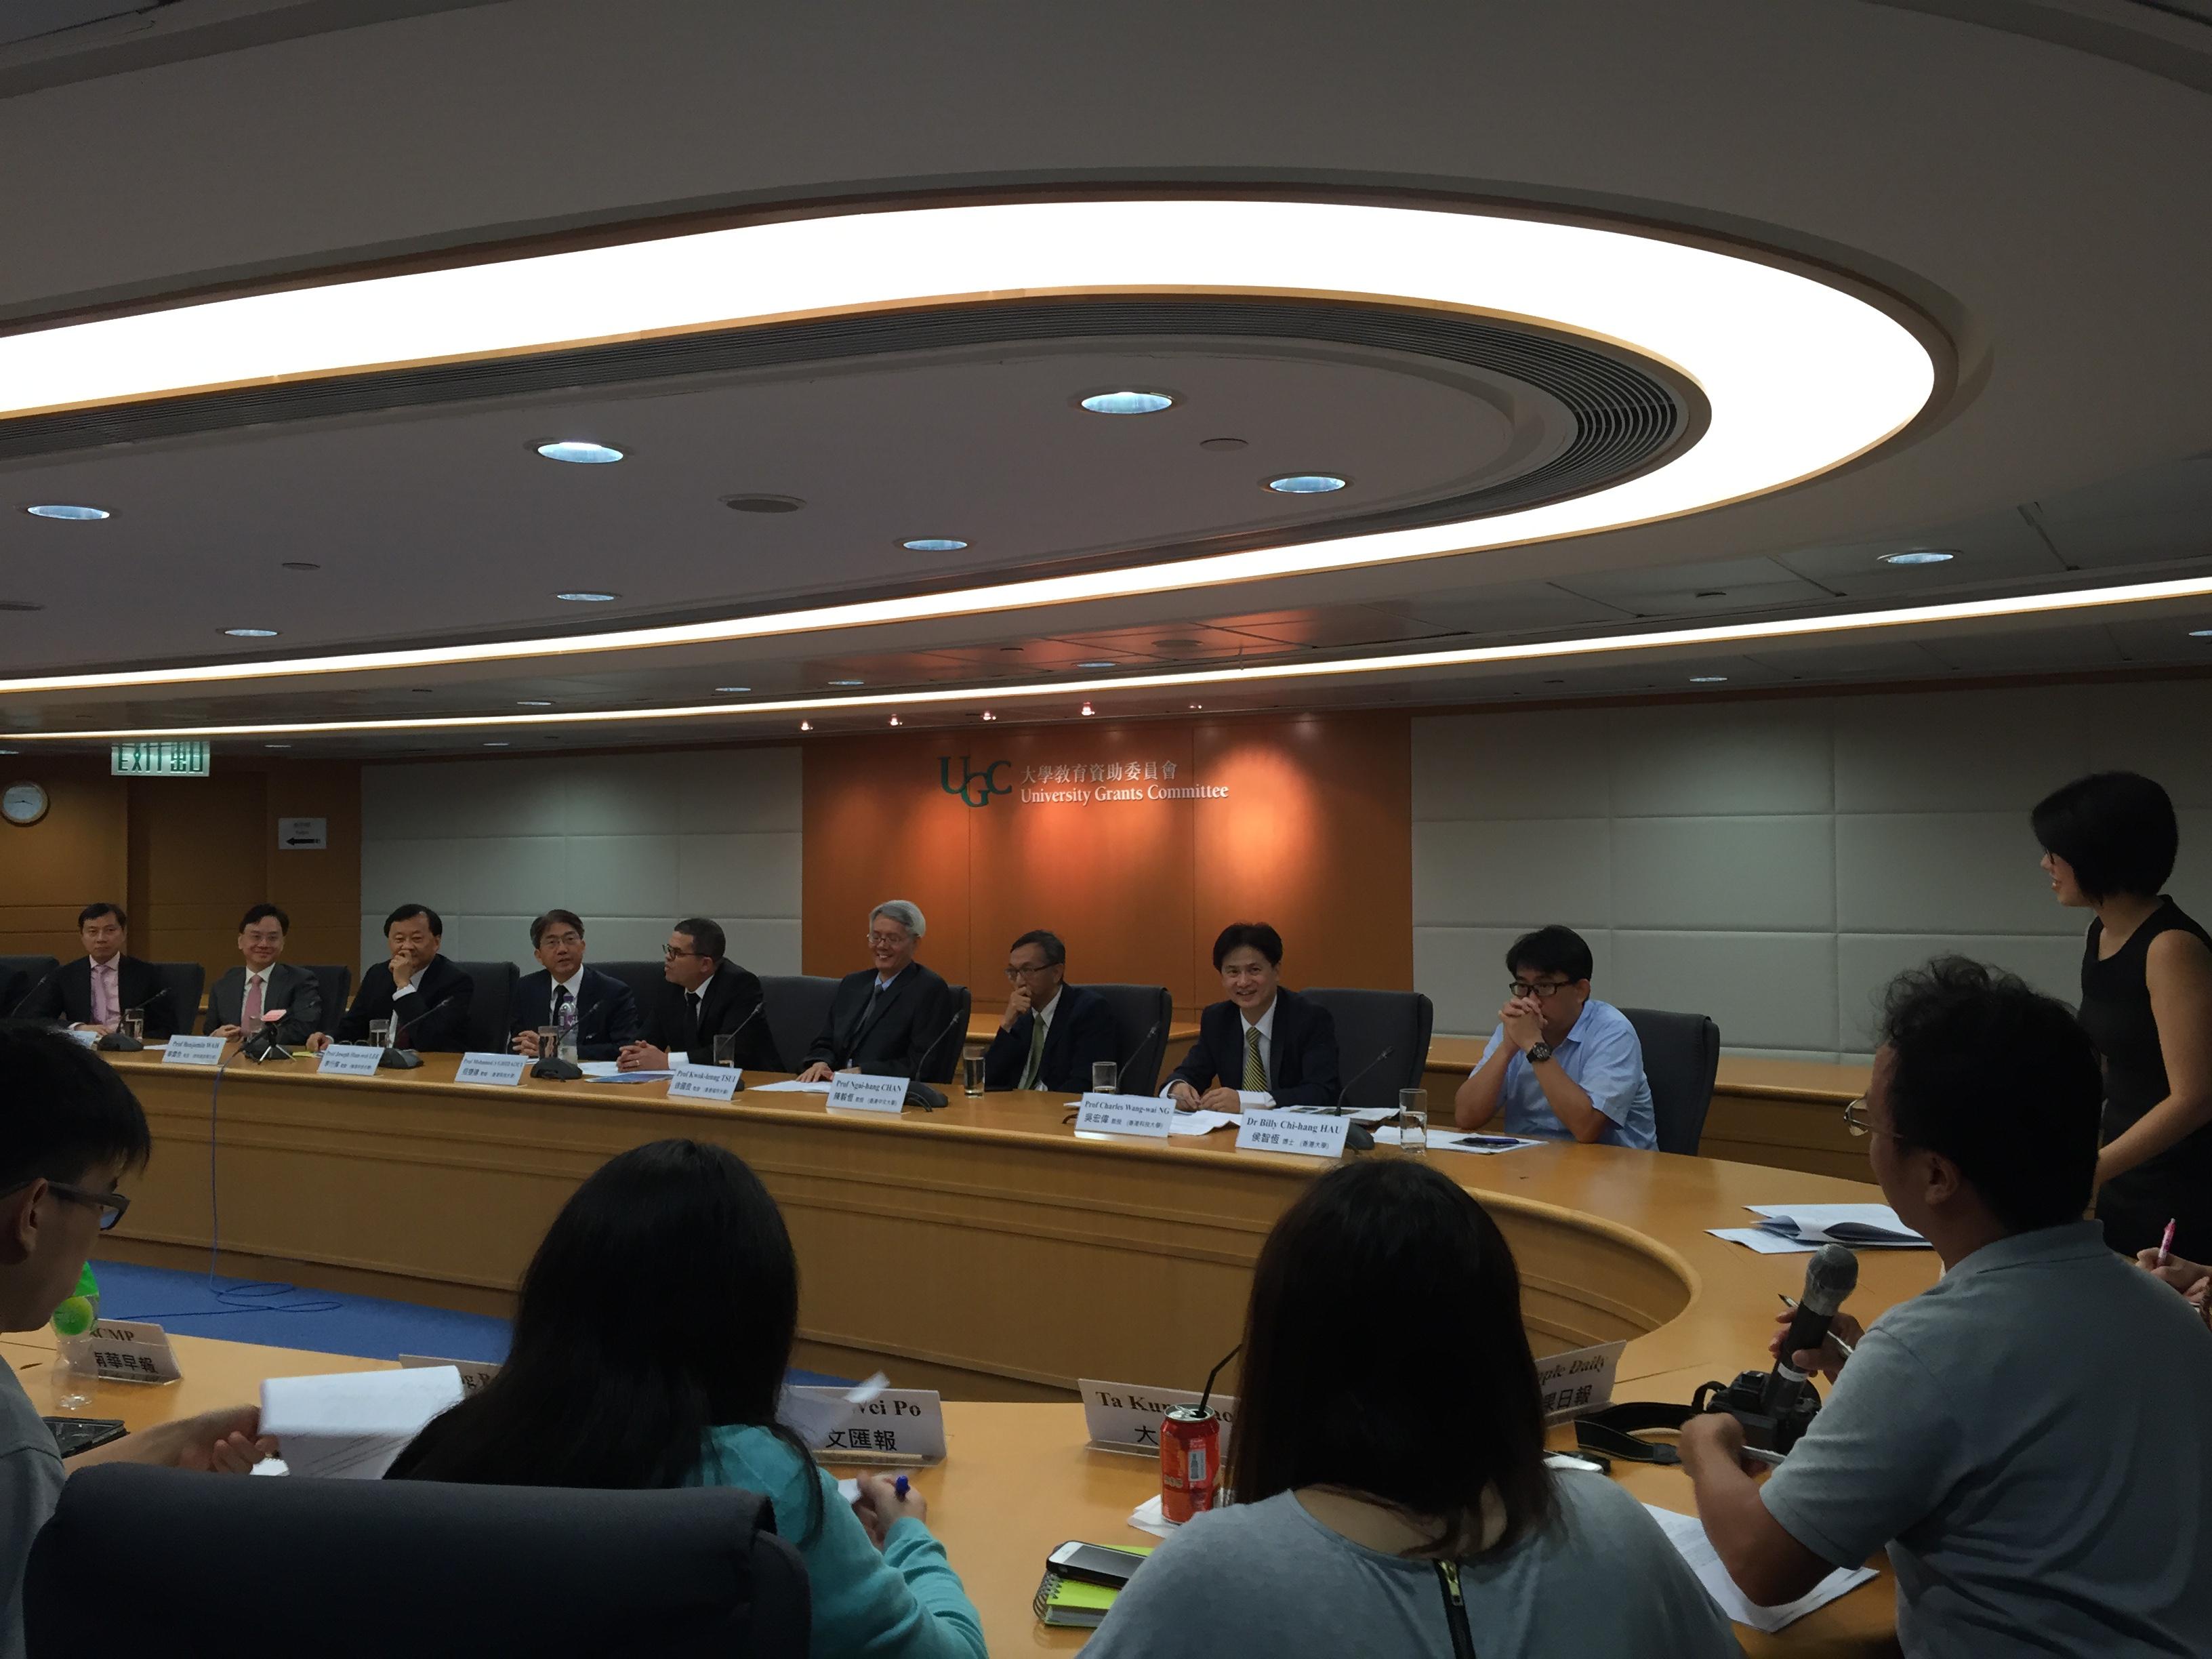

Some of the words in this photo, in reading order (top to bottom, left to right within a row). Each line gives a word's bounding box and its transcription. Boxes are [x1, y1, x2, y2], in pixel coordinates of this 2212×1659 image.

[938, 755, 1012, 807] UGC
[1021, 760, 1178, 785] 大學教育資助委員會
[1021, 787, 1091, 806] University
[1095, 785, 1143, 801] Grants
[1147, 784, 1229, 800] Committee
[851, 1081, 880, 1091] Ngai-hang
[881, 1084, 902, 1092] CHAN
[1084, 1101, 1099, 1109] Prof
[1099, 1102, 1123, 1111] Charles
[1125, 1104, 1157, 1113] Wang-wai
[1159, 1107, 1170, 1115] NG
[1247, 1117, 1258, 1126] Dr
[1260, 1118, 1278, 1130] Billy
[1280, 1120, 1318, 1133] Chi-hang
[1319, 1124, 1342, 1134] HAU
[1569, 1355, 1607, 1374] Daily
[1095, 1391, 1123, 1408] Ta
[1541, 1385, 1593, 1410] 果日報
[893, 1400, 922, 1417] Po
[825, 1428, 897, 1452] 文匯報
